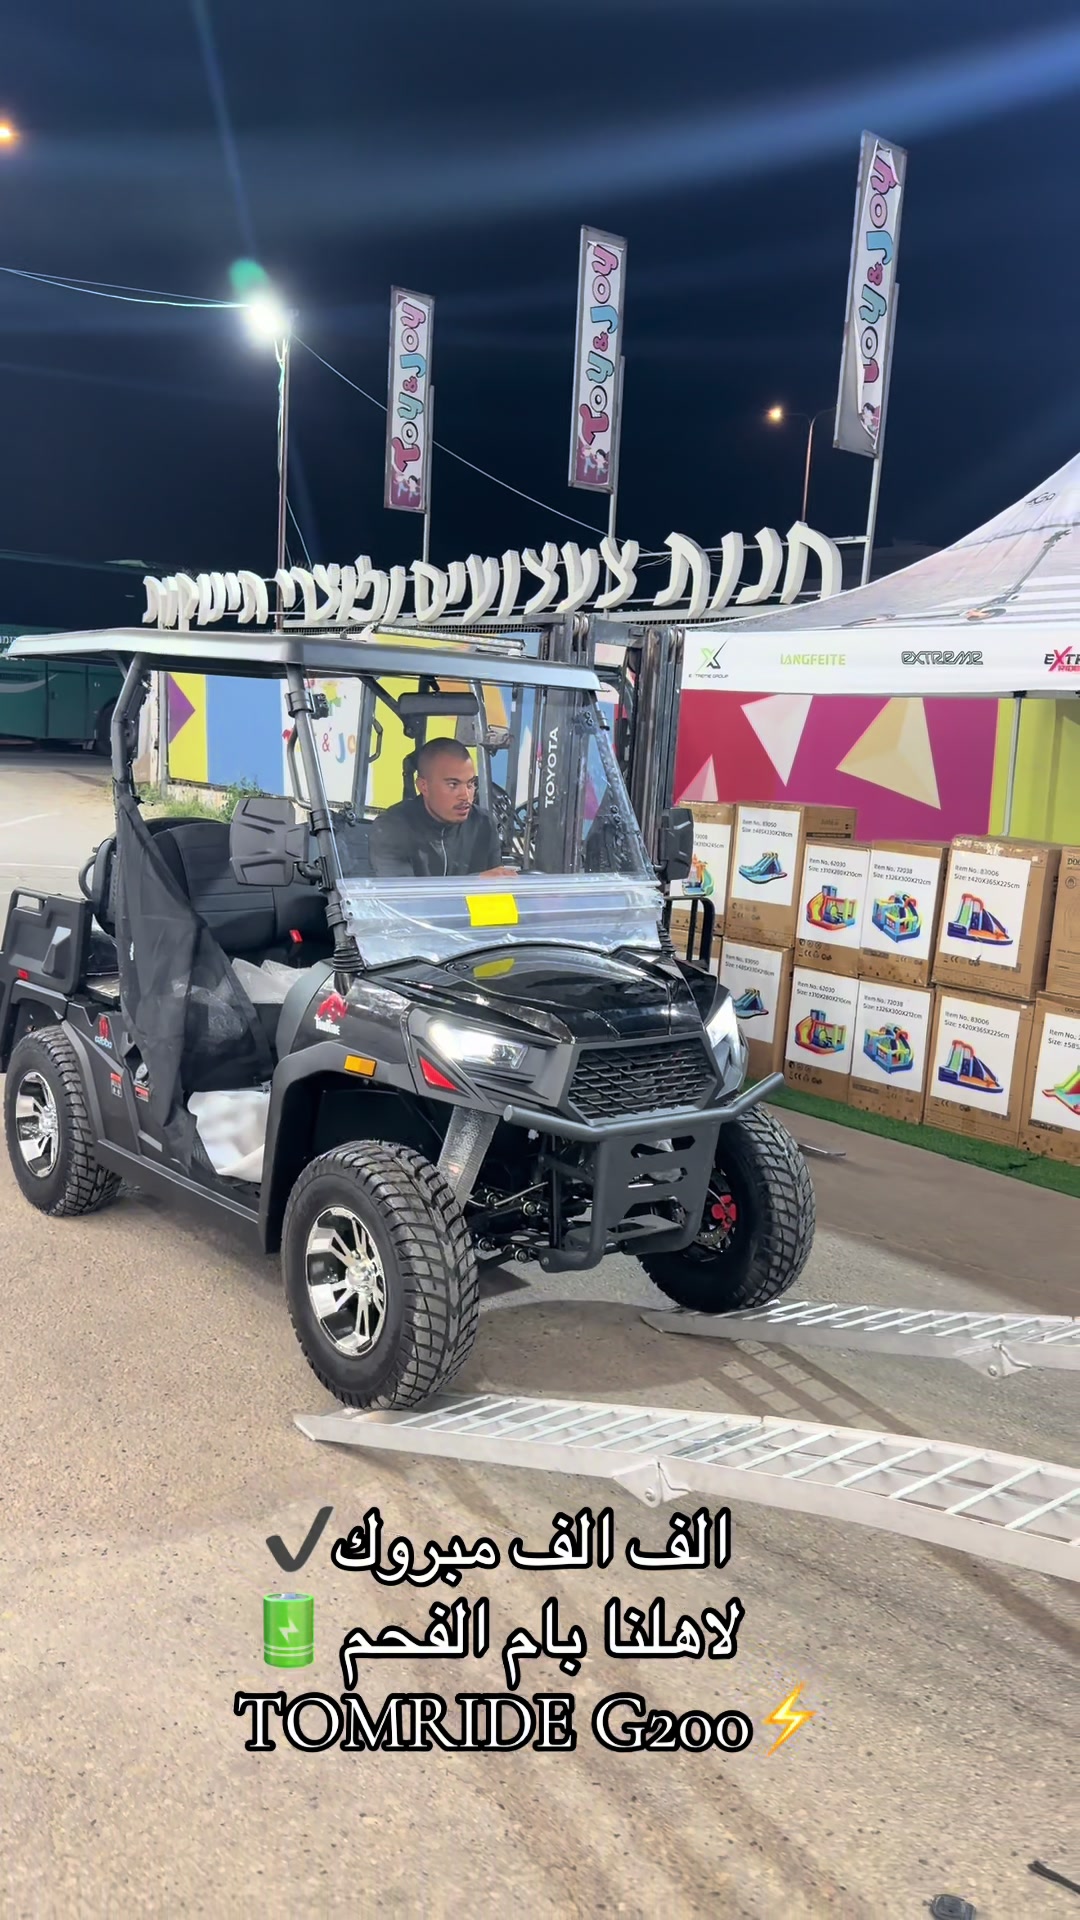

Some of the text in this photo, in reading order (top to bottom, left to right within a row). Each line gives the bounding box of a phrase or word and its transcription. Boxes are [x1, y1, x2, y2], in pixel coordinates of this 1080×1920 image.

[868, 261, 883, 286] &
[592, 331, 609, 352] &
[403, 376, 418, 393] &
[410, 535, 640, 624] צעצועים
[653, 520, 842, 619] חנות
[142, 569, 269, 631] תינוקות
[545, 726, 559, 808] TOYOTA
[970, 1015, 990, 1026] 83006
[1047, 1037, 1080, 1050] Size: ±585
[1049, 1028, 1064, 1037] Item
